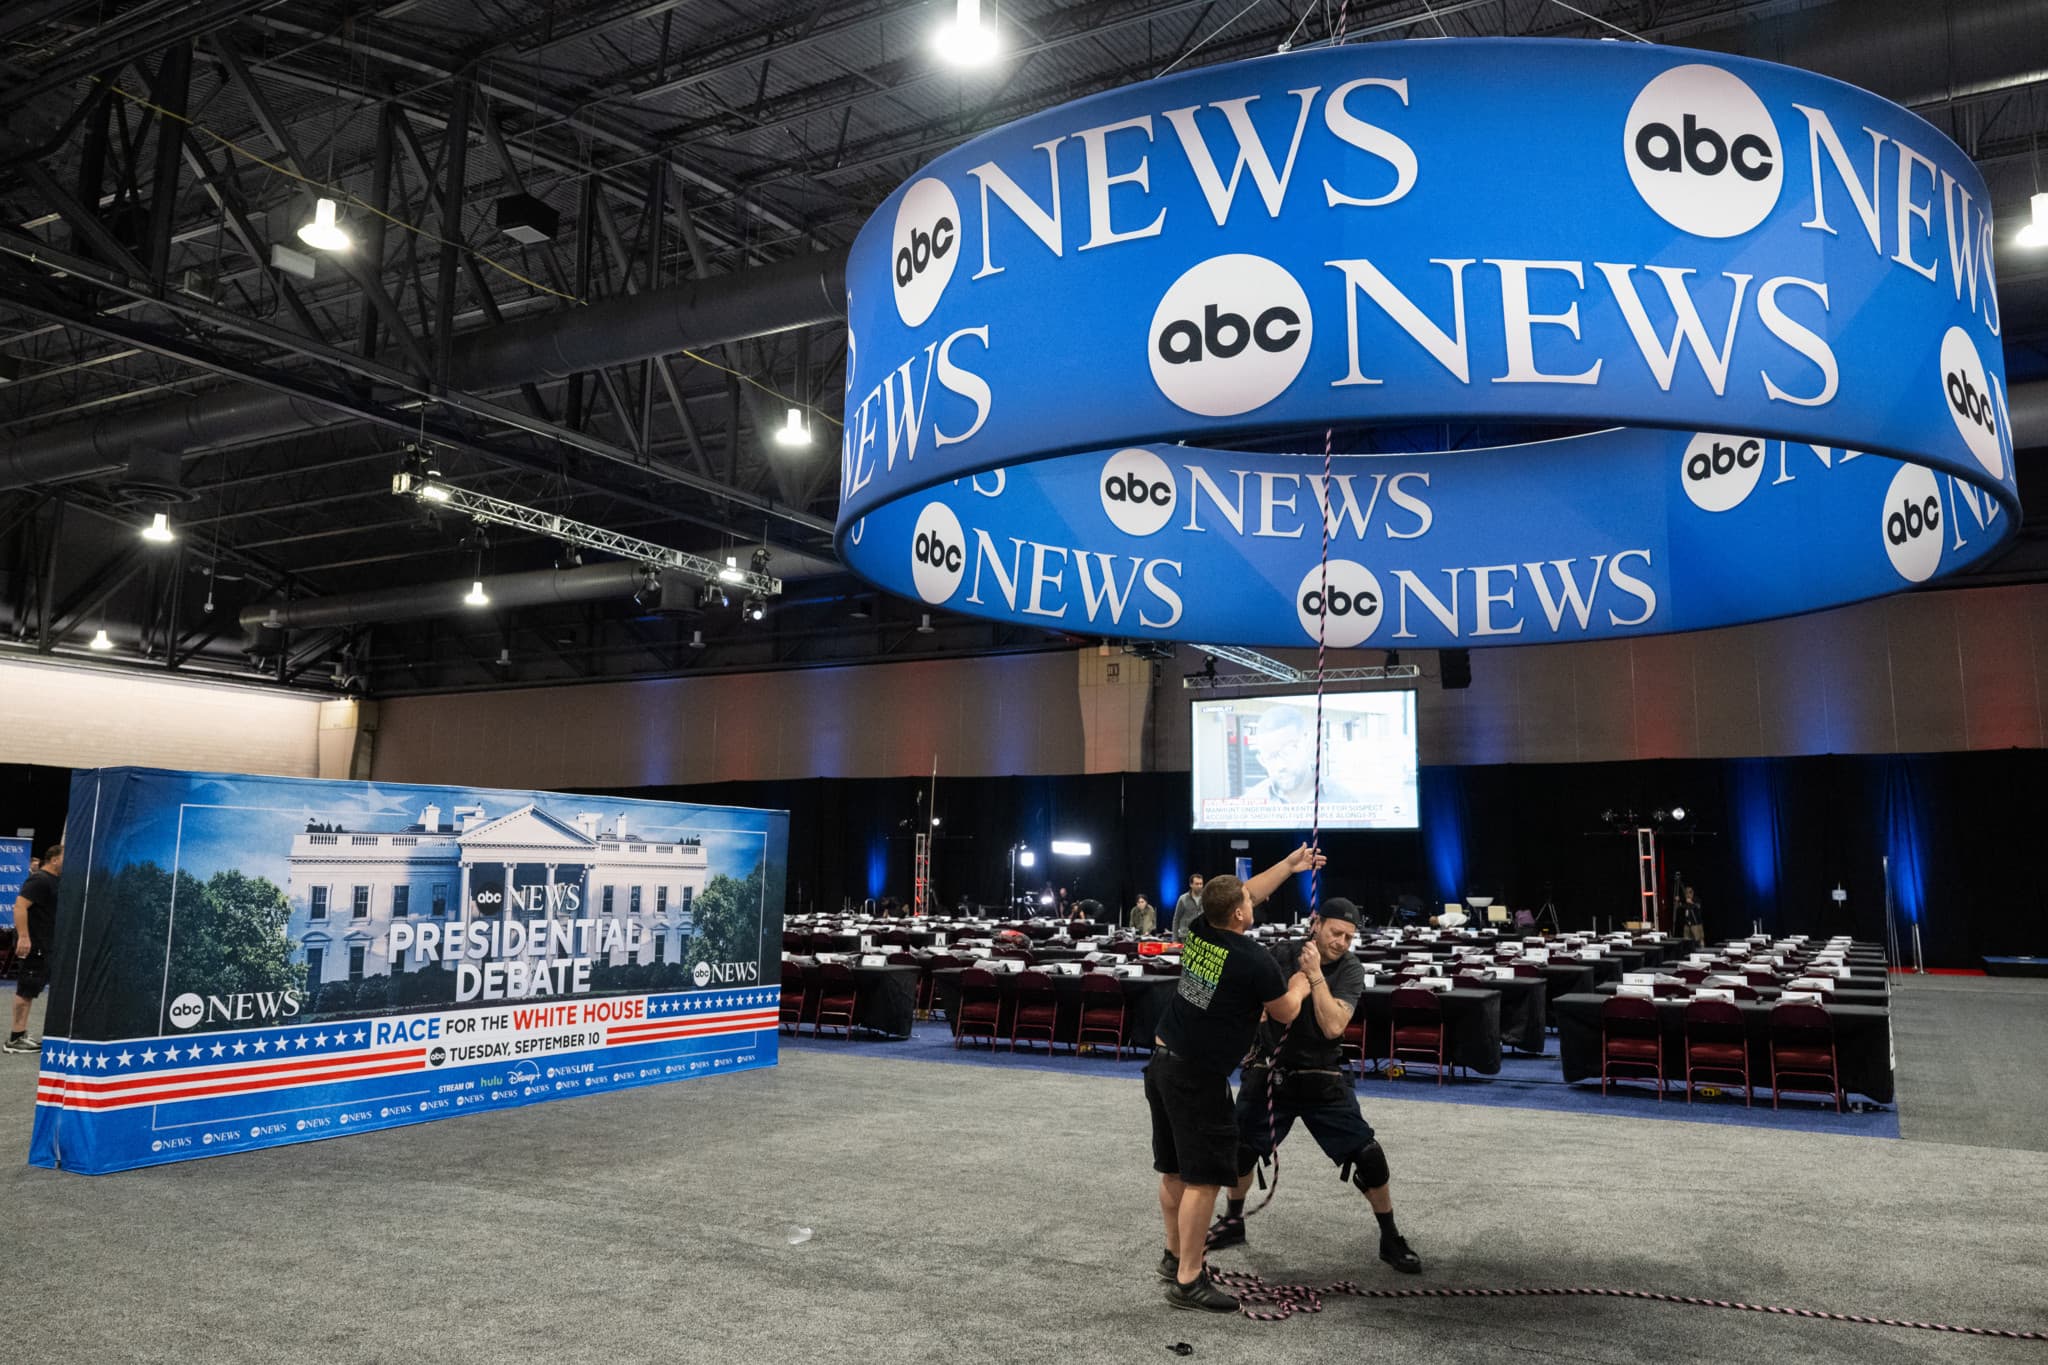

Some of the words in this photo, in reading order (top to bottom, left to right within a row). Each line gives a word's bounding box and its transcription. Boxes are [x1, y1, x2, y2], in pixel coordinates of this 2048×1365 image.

[896, 215, 954, 288] abc
[966, 76, 1418, 282] NEWS
[1635, 112, 1774, 183] abc
[1792, 102, 2001, 338] NEWS
[1157, 302, 1302, 366] abc
[1323, 257, 1840, 408] NEWS
[843, 324, 992, 504] NEWS
[1945, 368, 1995, 437] abc
[1687, 439, 1760, 481] abc
[1104, 472, 1172, 507] abc
[1182, 463, 1434, 541] NEWS
[1887, 494, 1940, 547] abc
[914, 529, 963, 574] abc
[966, 526, 1183, 629] NEWS
[1302, 585, 1378, 617] abc
[1390, 548, 1657, 639] NEWS
[477, 890, 502, 905] abc
[507, 884, 582, 912] NEWS
[387, 918, 643, 964] PRESIDENTIAL
[455, 957, 592, 1002] DEBATE
[711, 961, 757, 983] NEWS
[172, 1003, 202, 1016] abc
[205, 989, 300, 1023] NEWS
[376, 1017, 441, 1045] RACE
[446, 1018, 476, 1034] FOR
[480, 1014, 509, 1030] THE
[513, 1005, 578, 1030] WHITE
[583, 999, 645, 1024] HOUSE
[430, 1052, 446, 1061] abc
[450, 1041, 511, 1061] TUESDAY,
[515, 1034, 586, 1054] SEPTEMBER
[588, 1032, 600, 1045] 10
[438, 1083, 464, 1093] STREAM
[465, 1081, 475, 1089] ON
[480, 1075, 503, 1087] hulu
[162, 1137, 192, 1149] NEWS
[212, 1130, 241, 1142] NEWS
[260, 1123, 287, 1135] NEWS
[305, 1118, 331, 1129] NEWS
